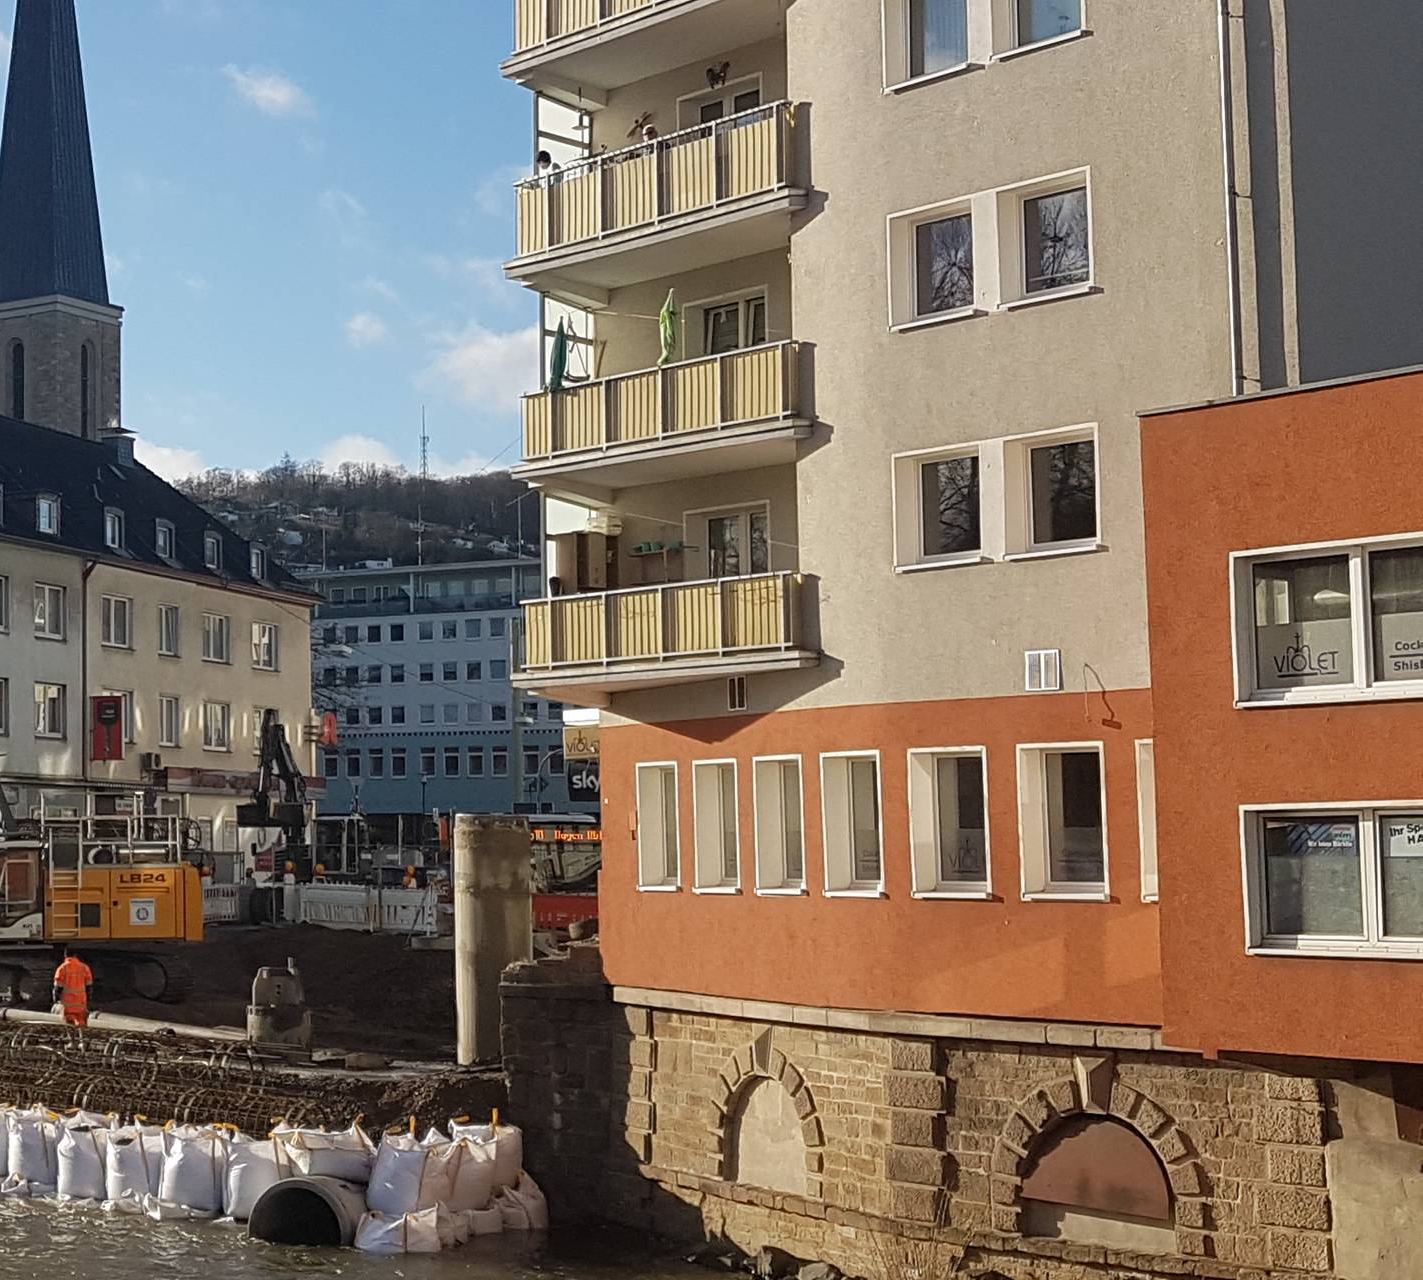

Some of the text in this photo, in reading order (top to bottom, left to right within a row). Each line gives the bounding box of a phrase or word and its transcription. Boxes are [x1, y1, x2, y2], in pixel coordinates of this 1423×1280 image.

[1273, 645, 1338, 672] VIOLET
[1406, 823, 1423, 834] Sp
[120, 873, 166, 883] LB24
